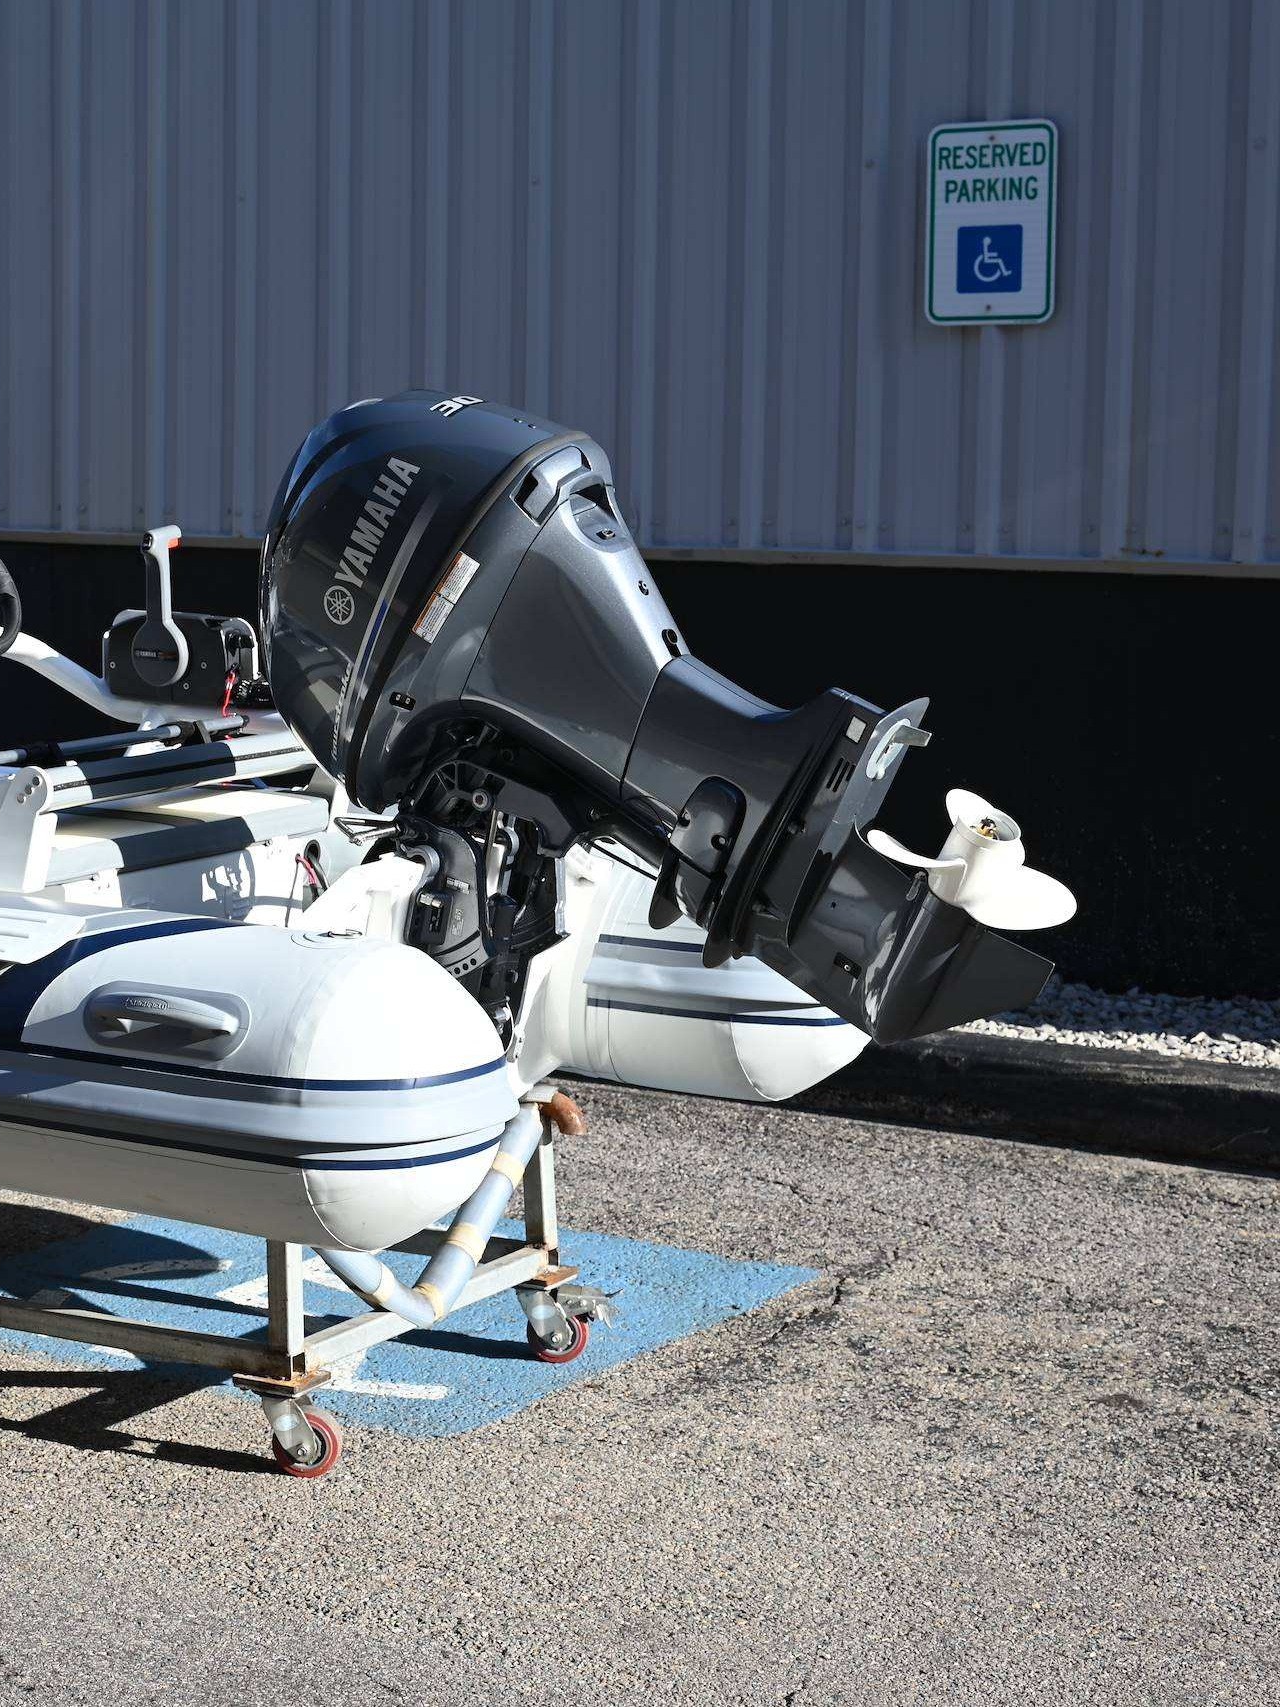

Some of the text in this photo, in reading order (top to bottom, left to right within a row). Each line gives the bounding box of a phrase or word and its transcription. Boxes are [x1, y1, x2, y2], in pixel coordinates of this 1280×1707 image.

[937, 142, 1046, 170] RESERVED
[944, 176, 1039, 203] PARKING
[429, 395, 485, 417] 30
[334, 456, 421, 589] YAMAHA
